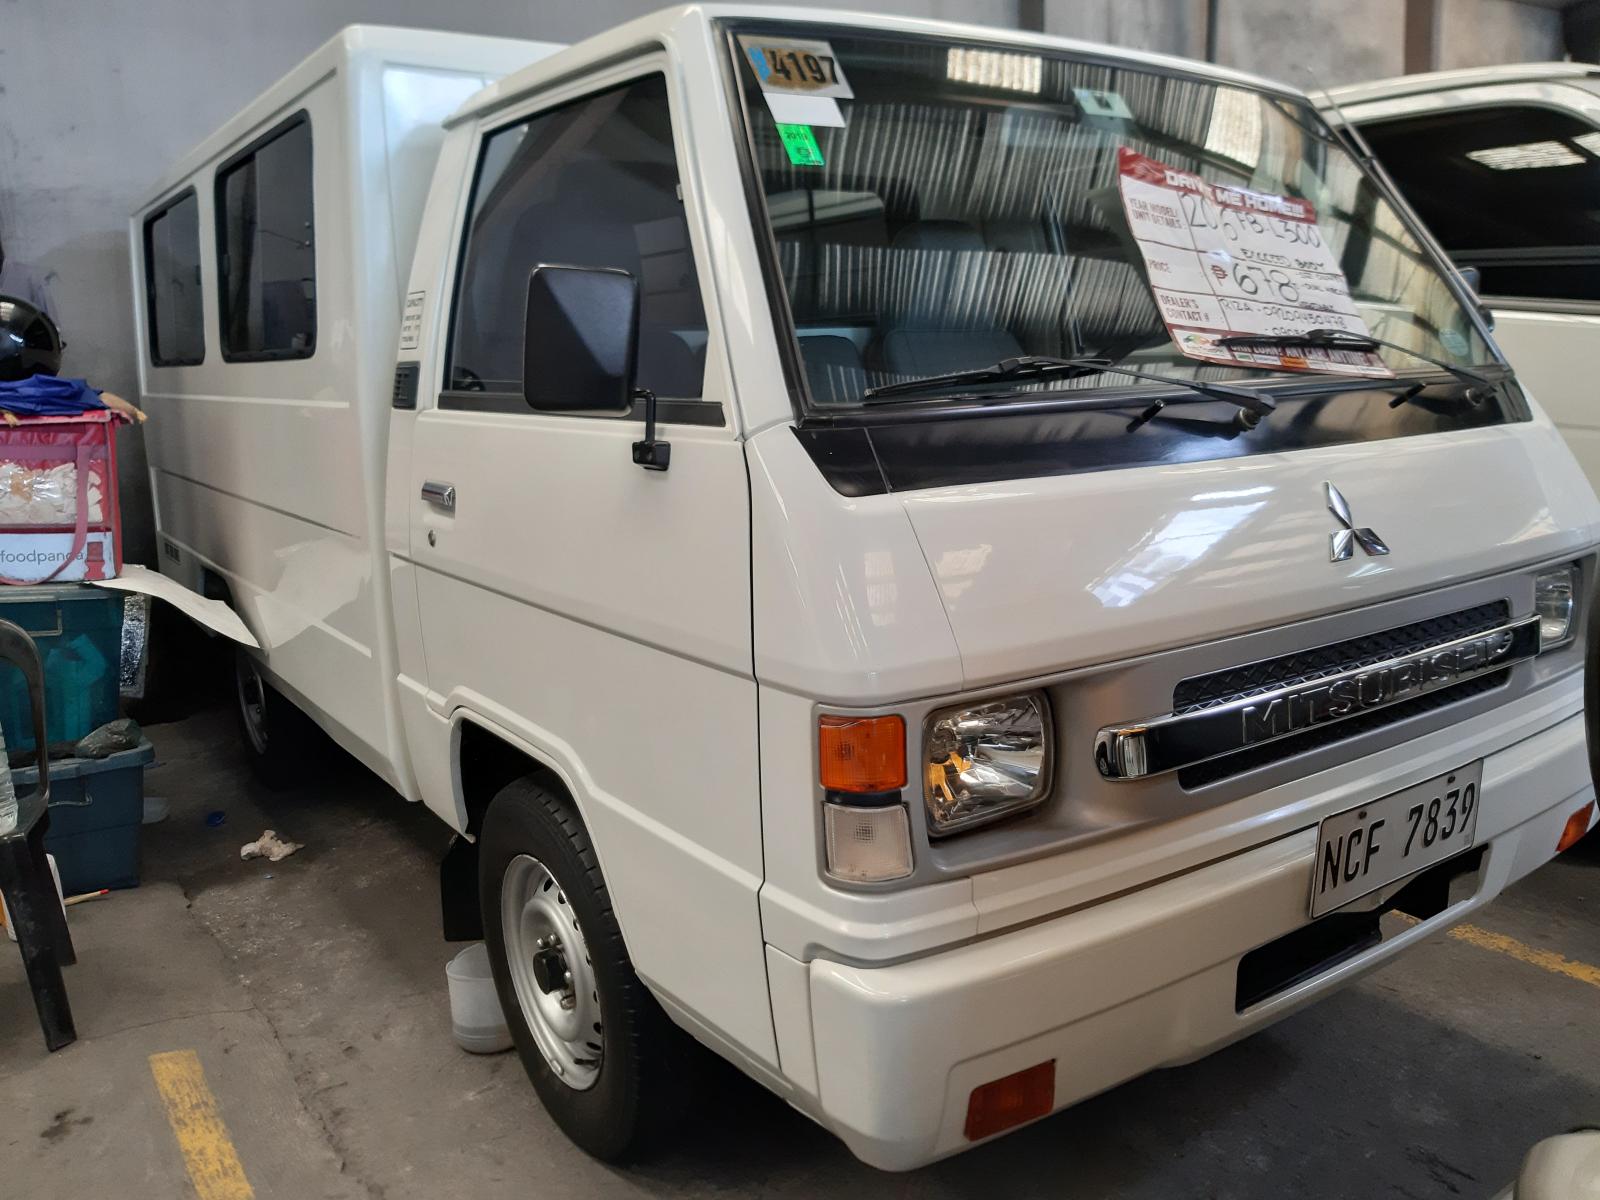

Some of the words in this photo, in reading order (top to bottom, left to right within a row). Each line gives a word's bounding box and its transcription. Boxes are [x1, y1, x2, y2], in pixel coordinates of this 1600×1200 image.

[768, 50, 840, 86] 4197
[1215, 189, 1243, 208] ME
[1148, 259, 1173, 273] PRICE
[1160, 294, 1199, 309] DEALER'S
[1165, 307, 1203, 322] CONTACT
[1242, 629, 1514, 746] MITSUBISHI
[1320, 818, 1386, 895] NCF
[1403, 782, 1476, 858] 7839
